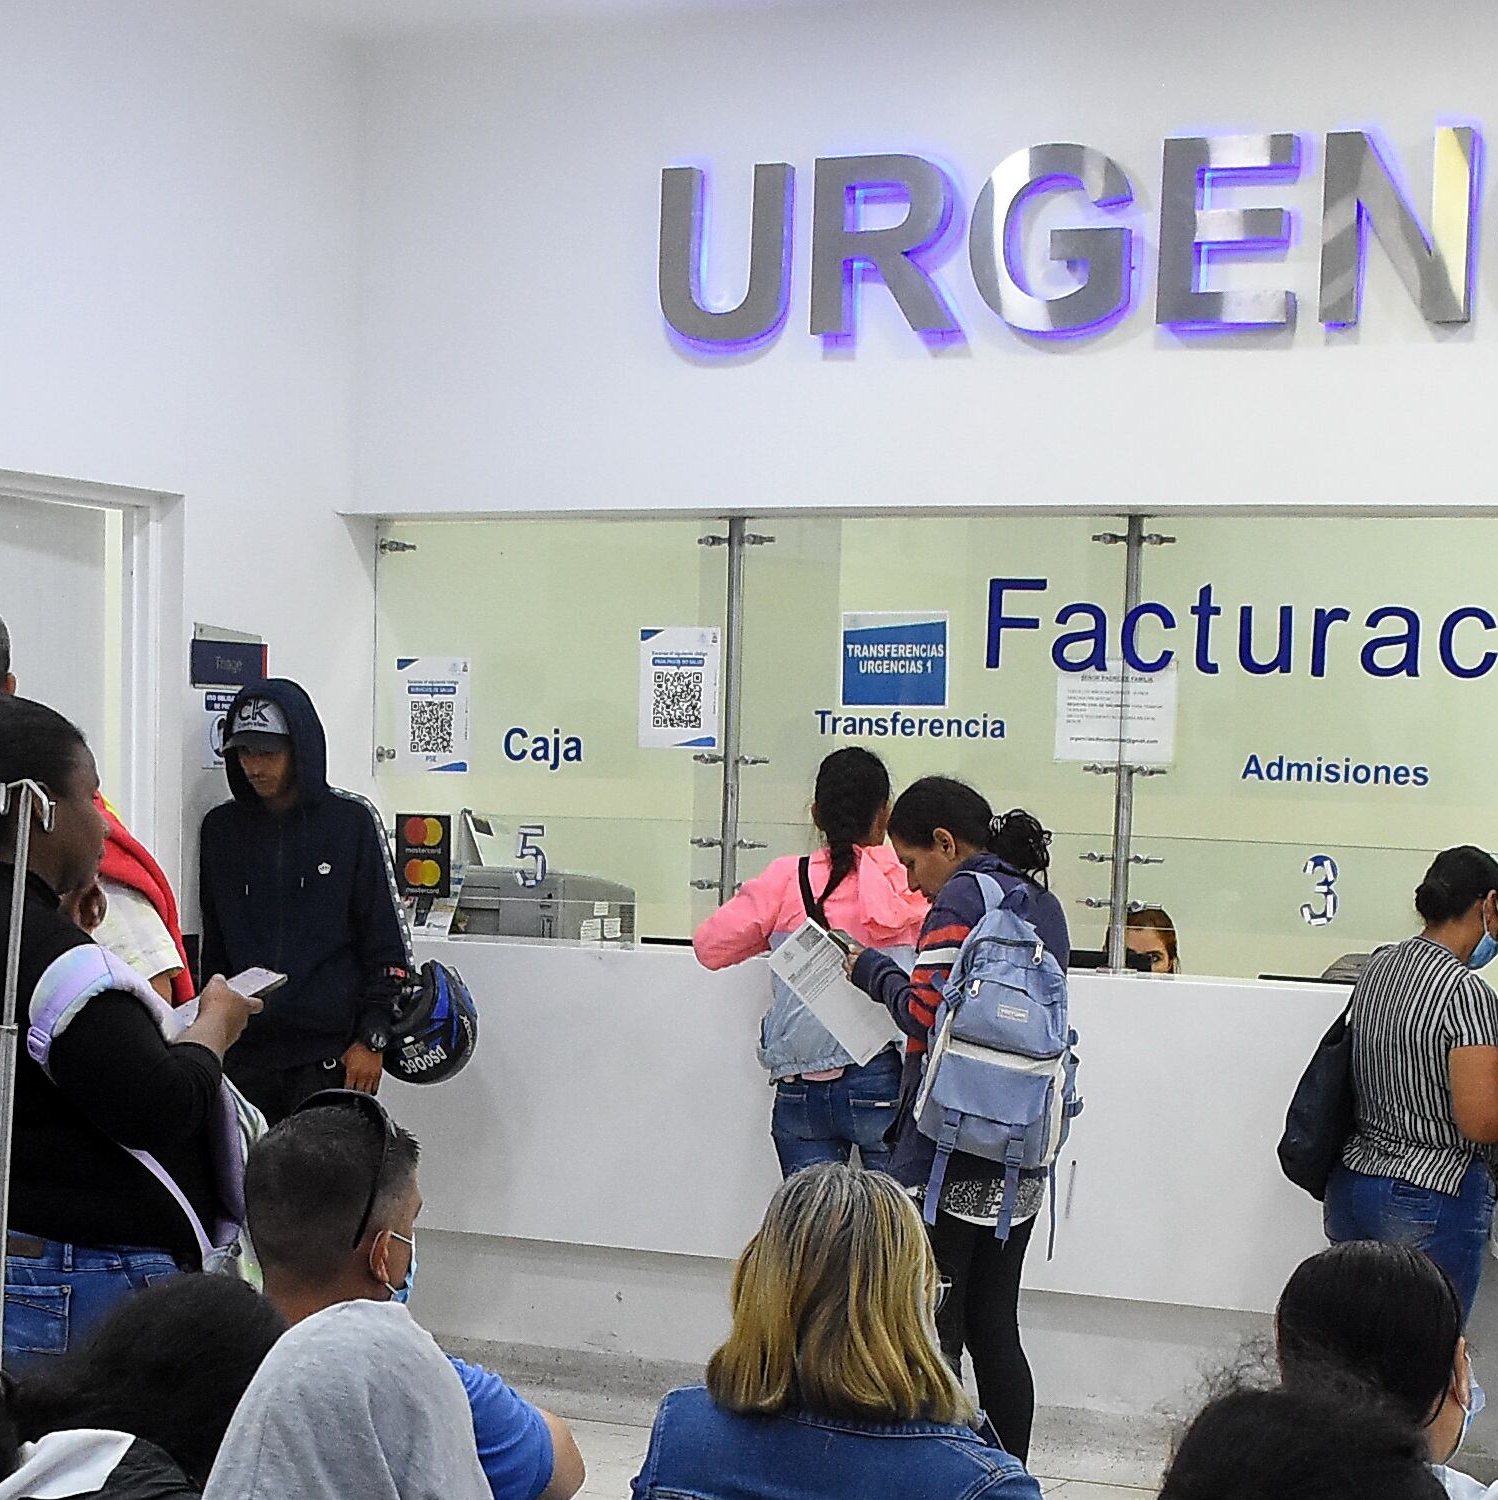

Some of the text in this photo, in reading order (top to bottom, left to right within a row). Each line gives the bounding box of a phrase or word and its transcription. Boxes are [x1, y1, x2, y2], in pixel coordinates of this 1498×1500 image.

[846, 643, 944, 659] TRANSFERENCIAS
[858, 658, 932, 675] URGENCIAS 1
[238, 698, 270, 722] CK
[814, 710, 1006, 739] Transferencia
[502, 726, 582, 770] Caja
[1242, 755, 1430, 787] Admisiones
[404, 847, 442, 855] mastercard
[514, 824, 547, 889] 5
[1299, 853, 1339, 927] 3
